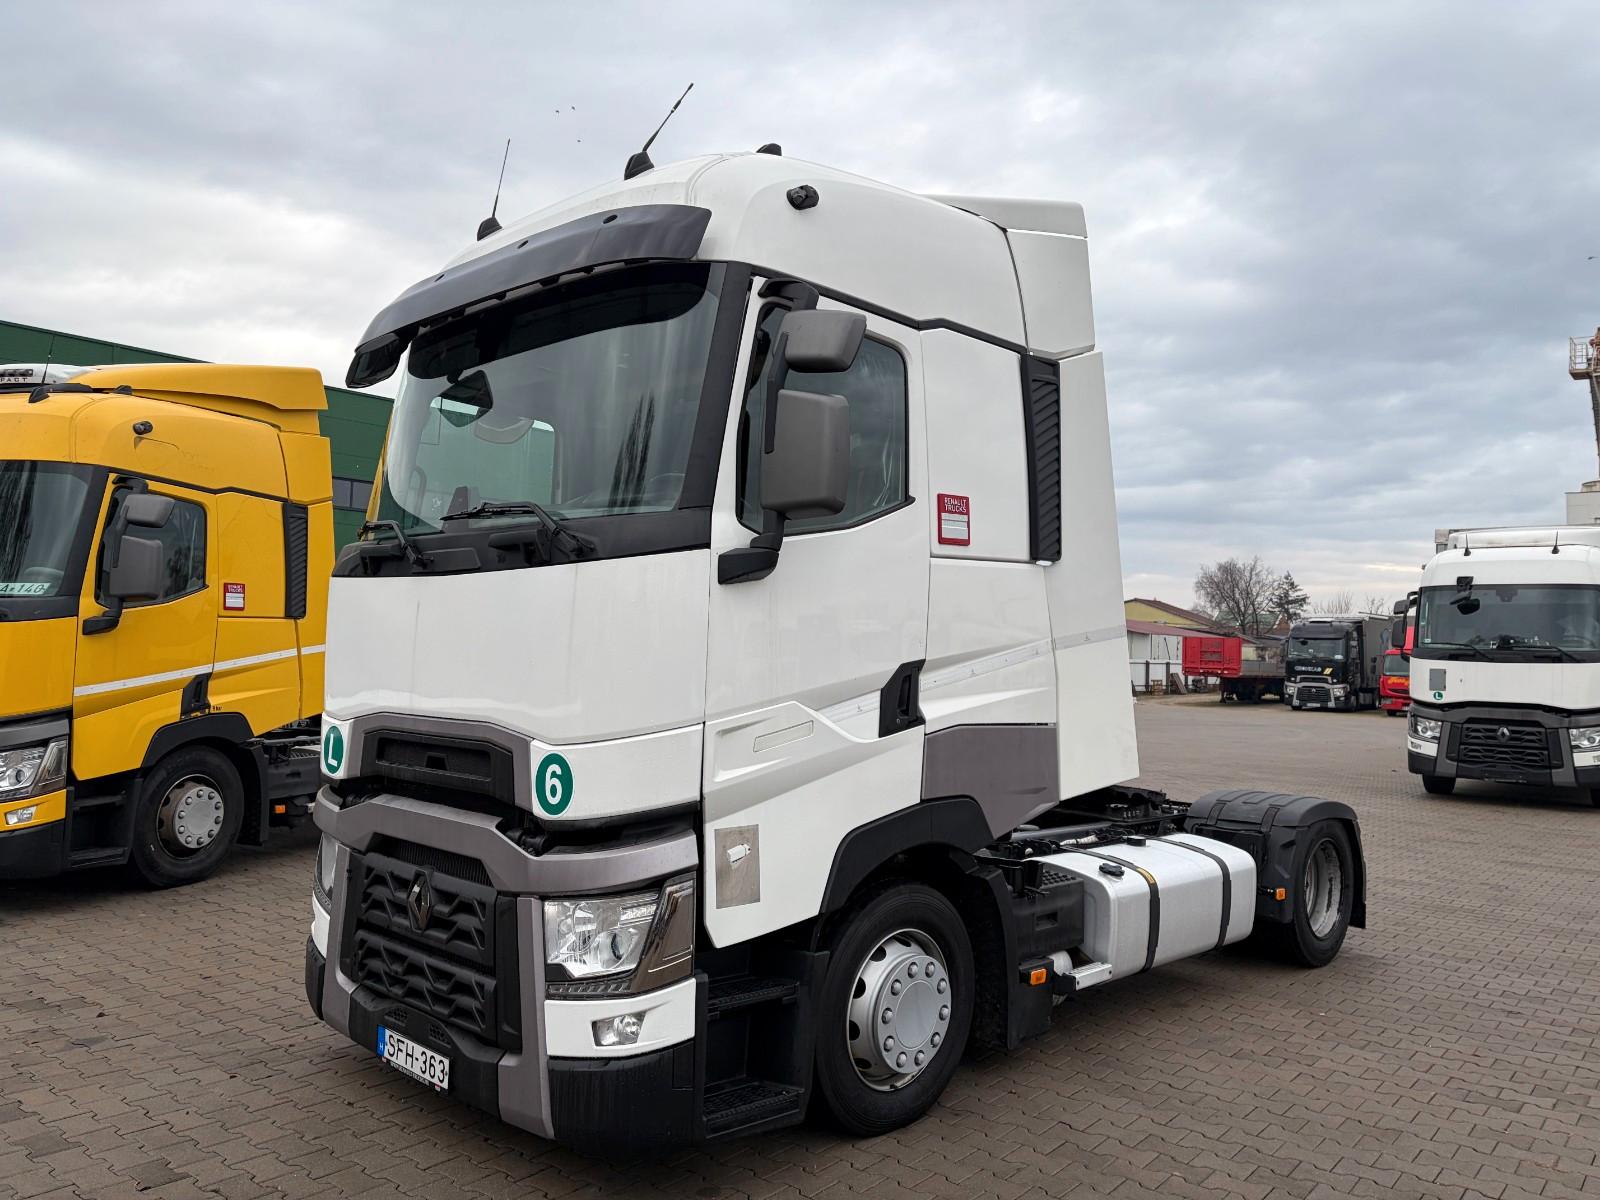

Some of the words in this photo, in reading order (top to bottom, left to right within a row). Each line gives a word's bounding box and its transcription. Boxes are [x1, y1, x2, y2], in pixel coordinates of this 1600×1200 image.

[944, 503, 967, 513] TRUCKS
[327, 733, 338, 768] L
[545, 763, 562, 805] 6
[387, 1034, 446, 1084] SFH-363
